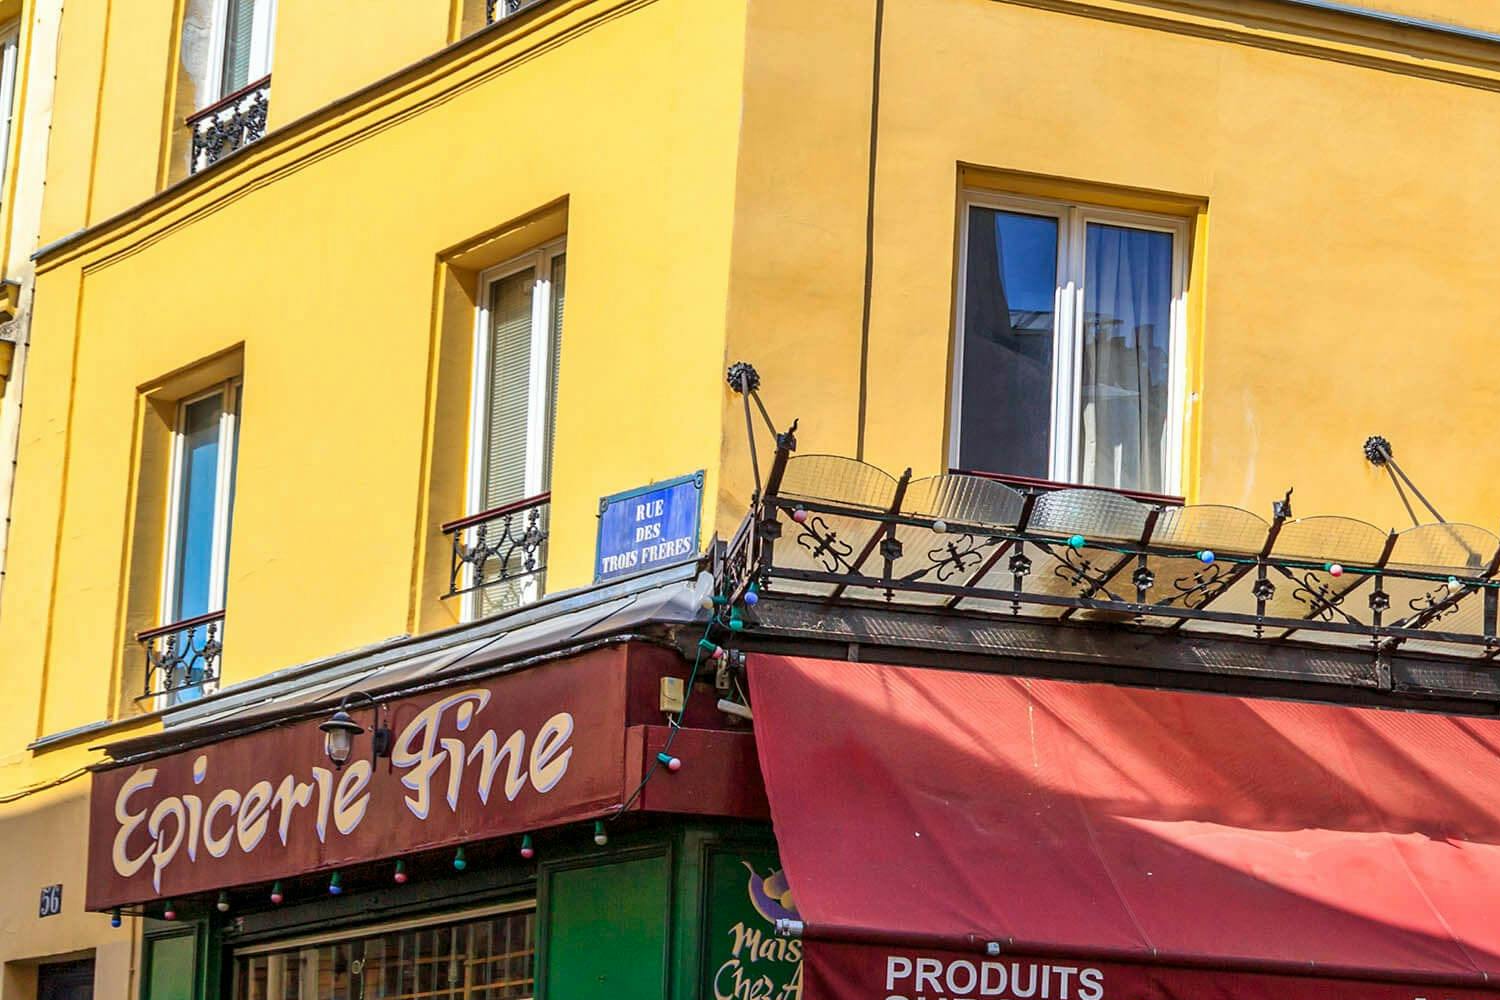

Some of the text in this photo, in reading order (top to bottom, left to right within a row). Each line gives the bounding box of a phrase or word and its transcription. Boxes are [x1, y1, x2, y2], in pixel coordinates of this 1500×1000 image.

[636, 499, 664, 521] RUE
[635, 523, 661, 543] DES
[602, 537, 692, 573] TROIS FRÈRES
[111, 688, 575, 895] Epicerie Fine
[41, 887, 60, 915] 56
[728, 921, 803, 963] Mais
